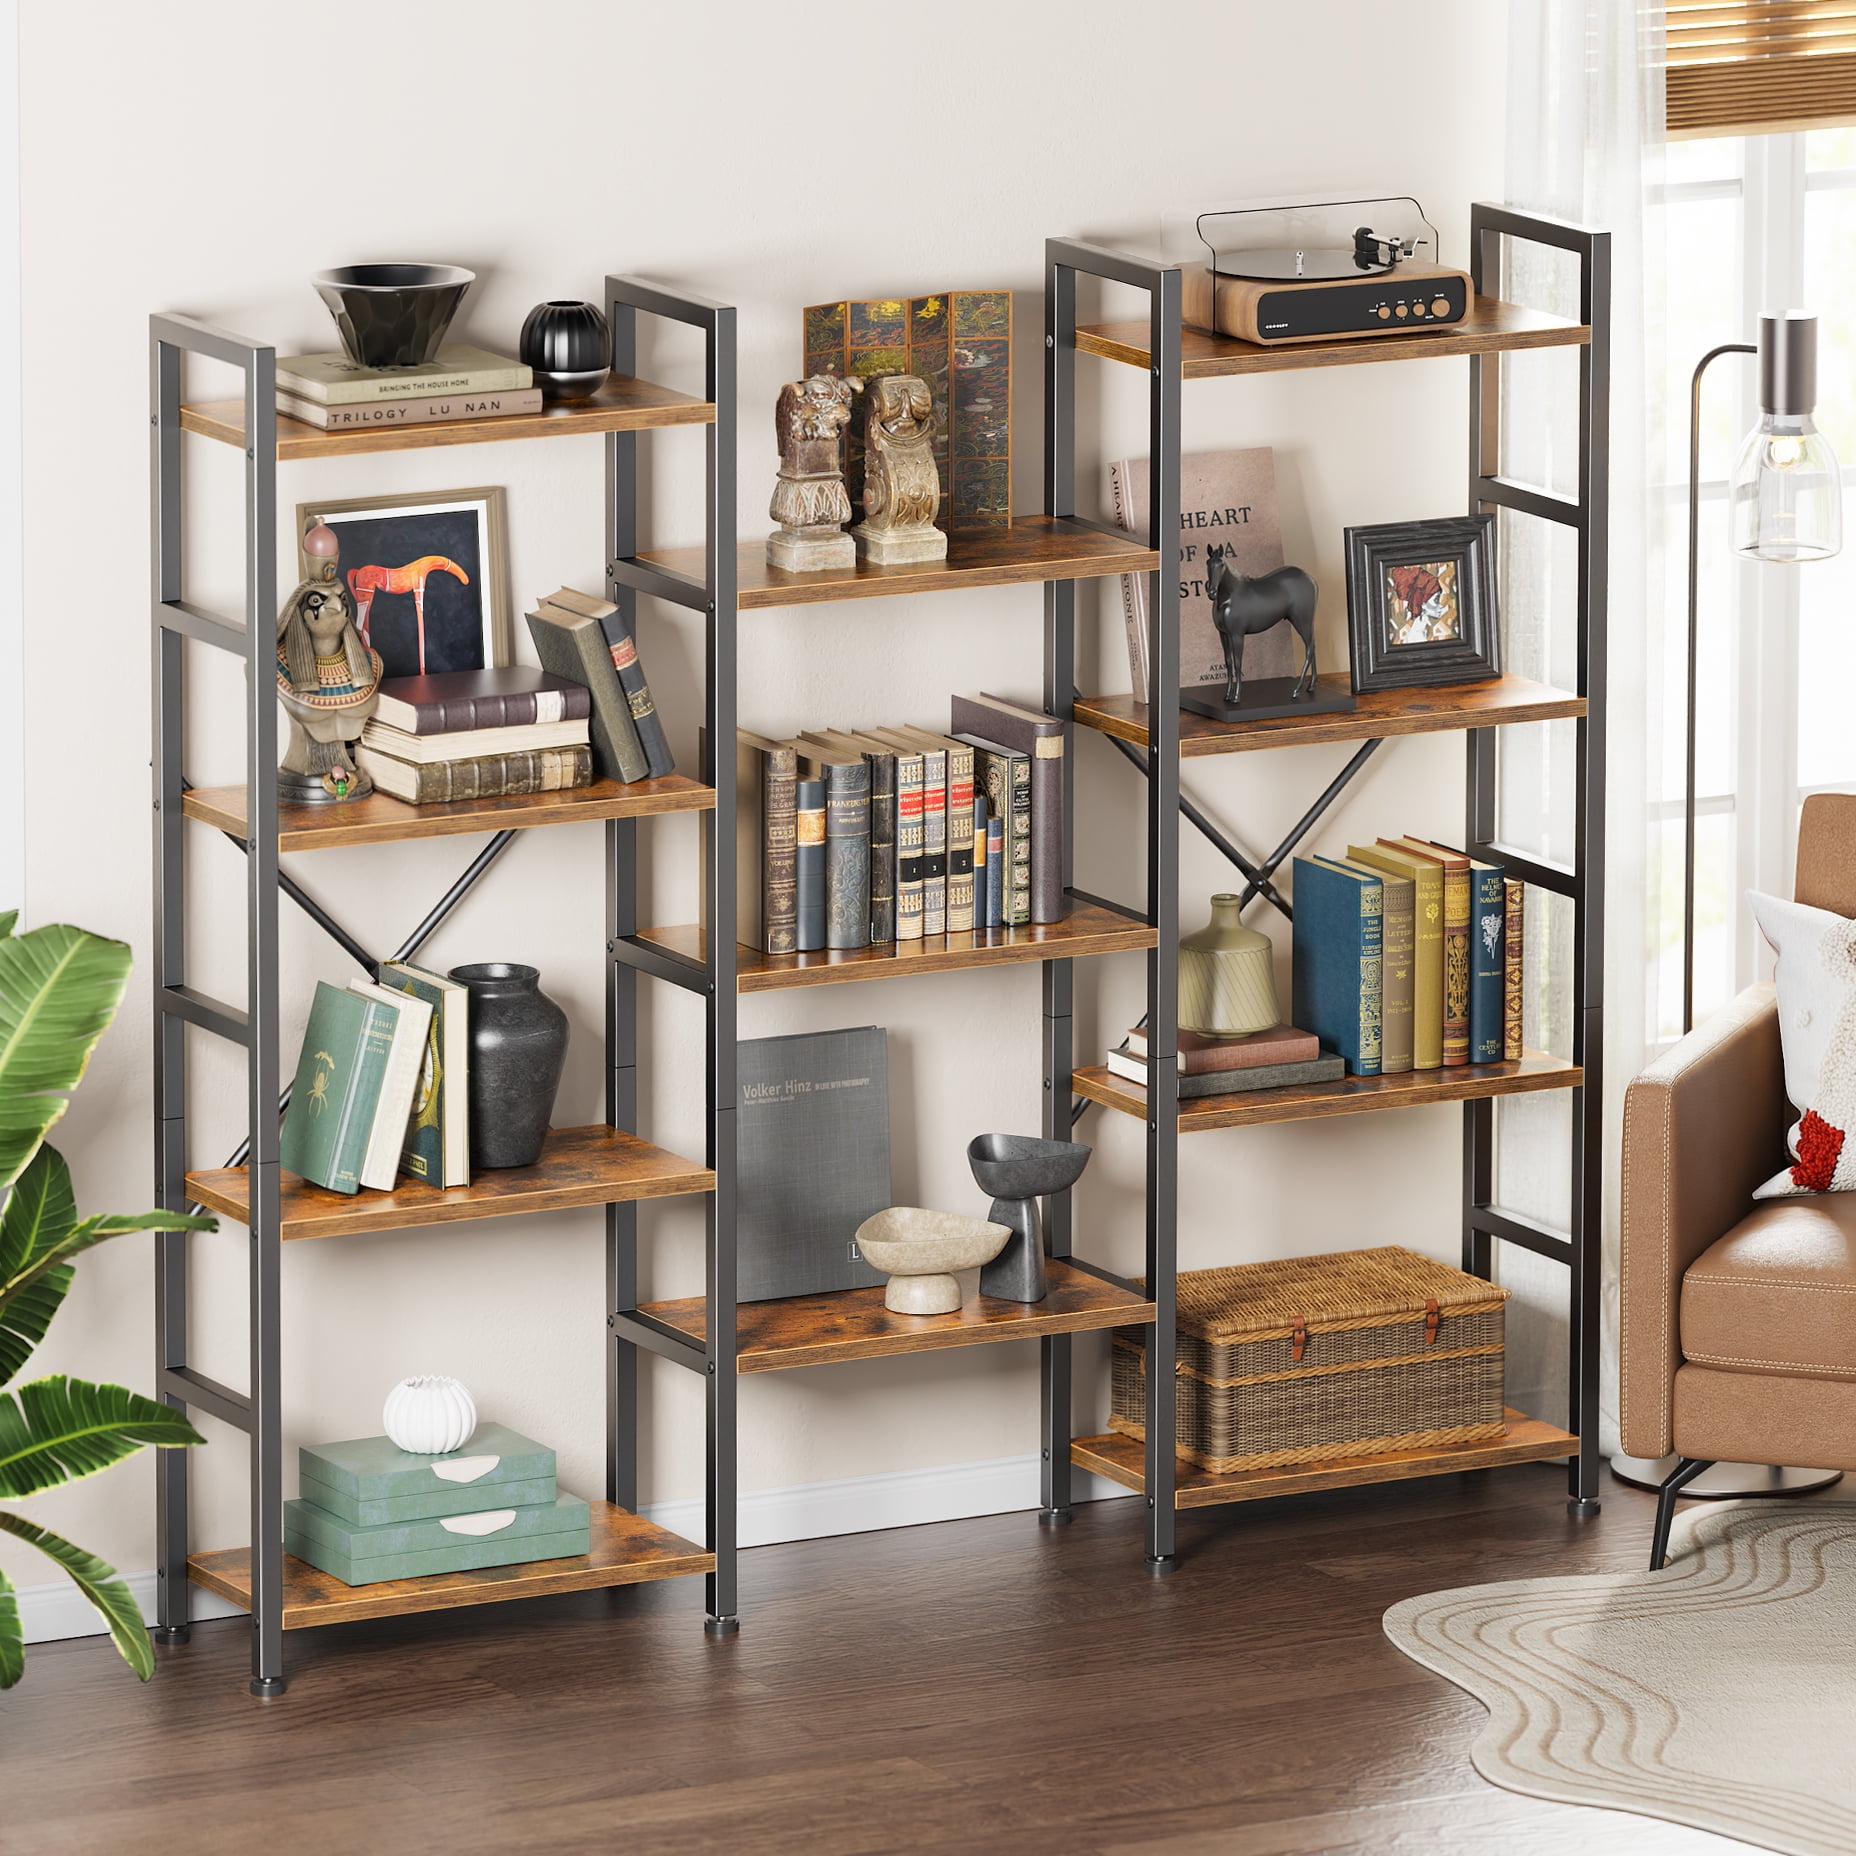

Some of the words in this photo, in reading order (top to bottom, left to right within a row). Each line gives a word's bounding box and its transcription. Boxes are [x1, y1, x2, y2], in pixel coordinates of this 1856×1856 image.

[379, 384, 411, 393] BRINGING
[427, 380, 449, 389] HOUSE
[450, 379, 469, 387] HOME
[331, 408, 407, 423] TRILOGY
[430, 405, 450, 415] LU
[465, 400, 500, 412] NAN
[1180, 507, 1251, 529] HEART
[1180, 545, 1198, 562] F
[1224, 542, 1238, 558] A
[1486, 877, 1500, 885] THE
[743, 1082, 782, 1099] Volker
[785, 1080, 812, 1094] Hinz
